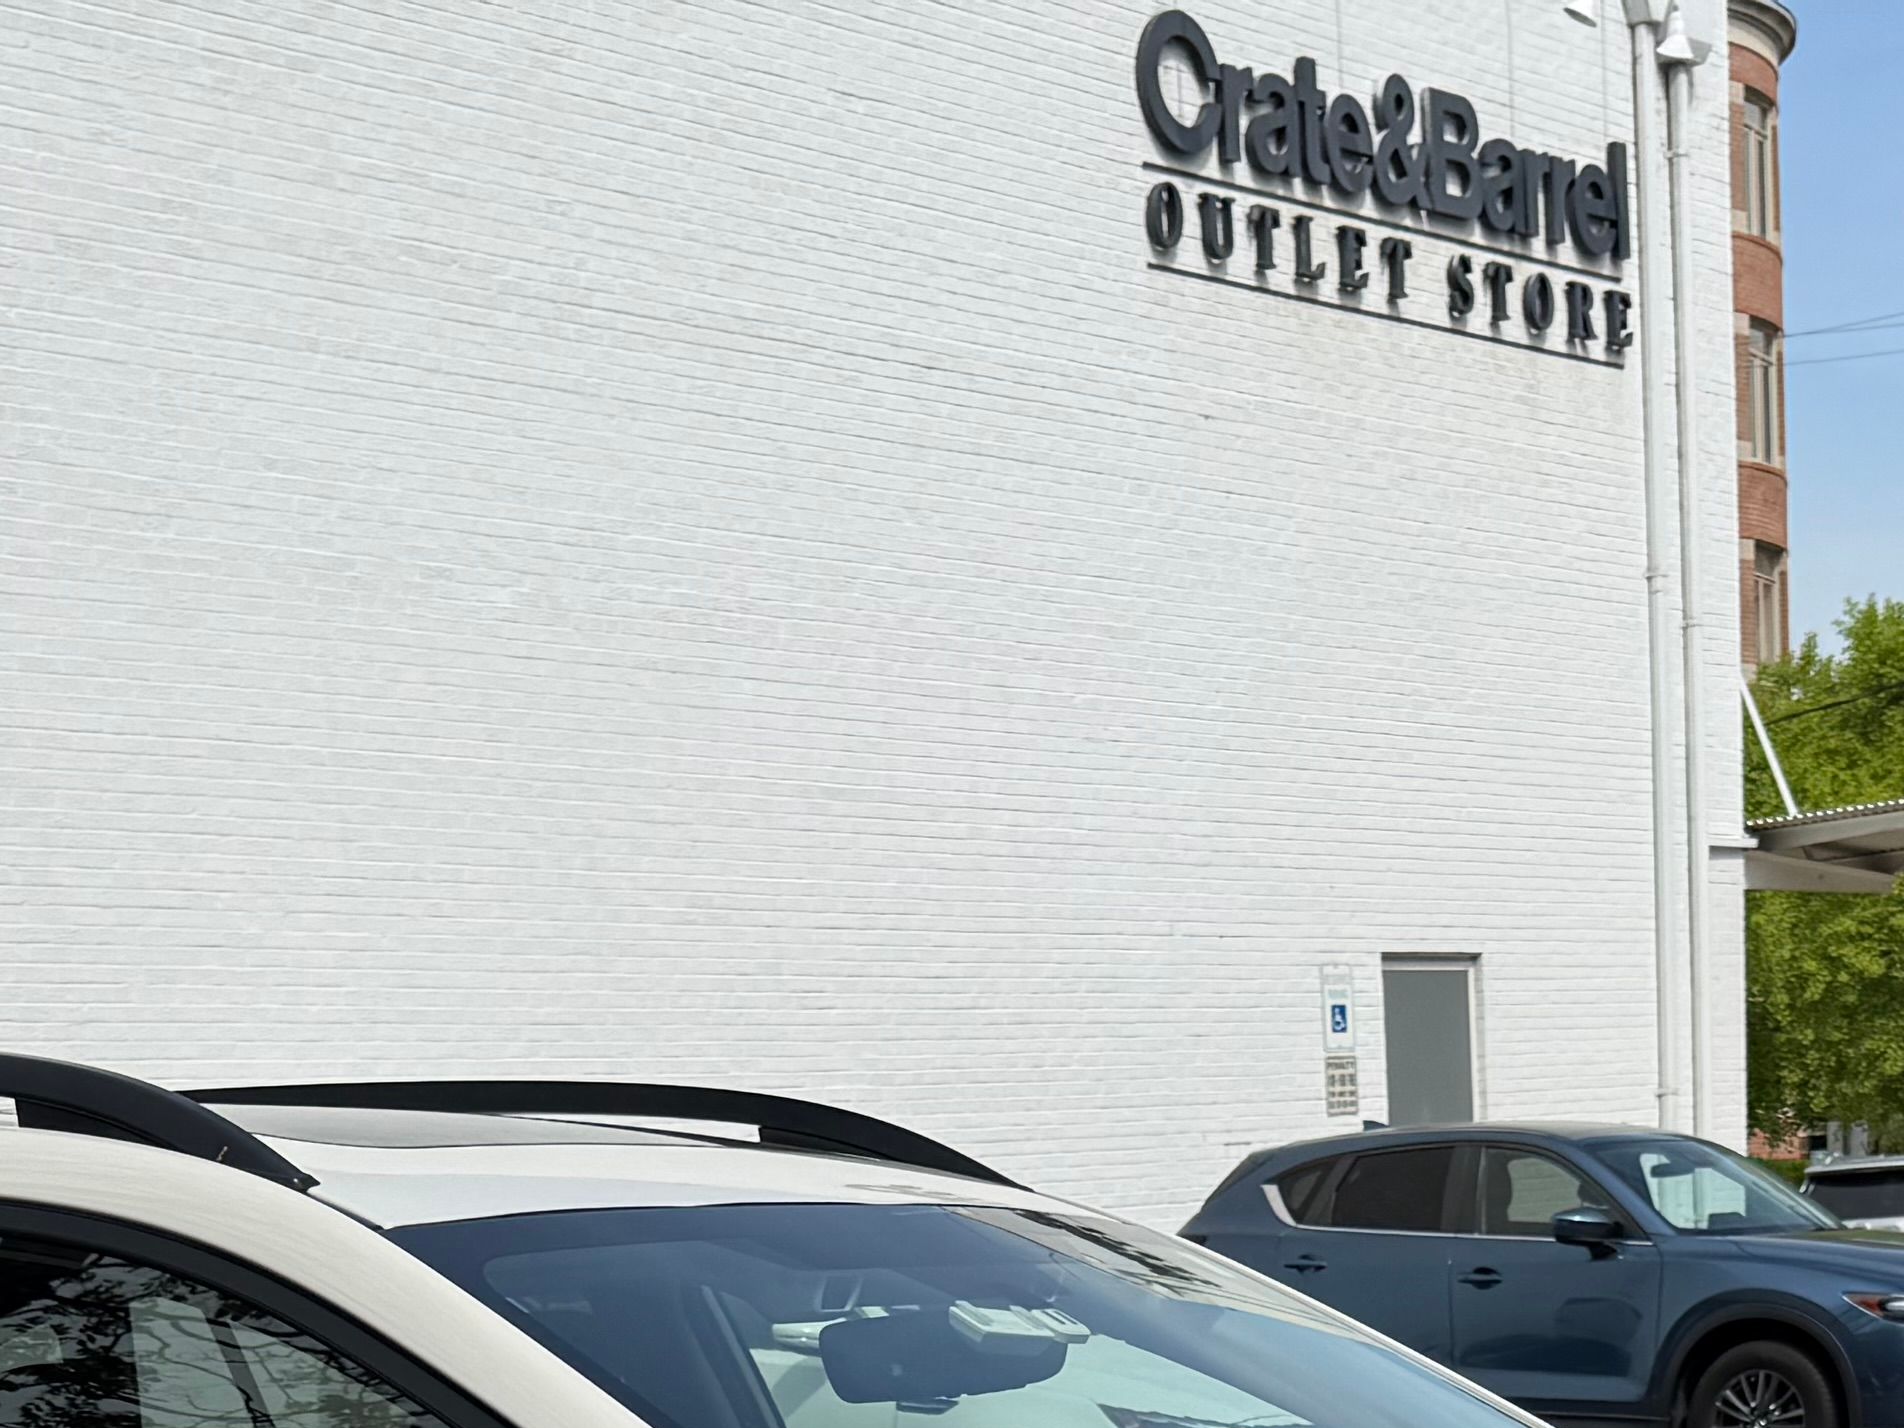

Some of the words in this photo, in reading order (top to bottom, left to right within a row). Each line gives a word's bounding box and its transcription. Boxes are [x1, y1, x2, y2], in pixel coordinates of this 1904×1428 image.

[1136, 9, 1631, 260] Crate&Barrel
[1146, 181, 1413, 302] OUTLET
[1447, 253, 1634, 352] STORE
